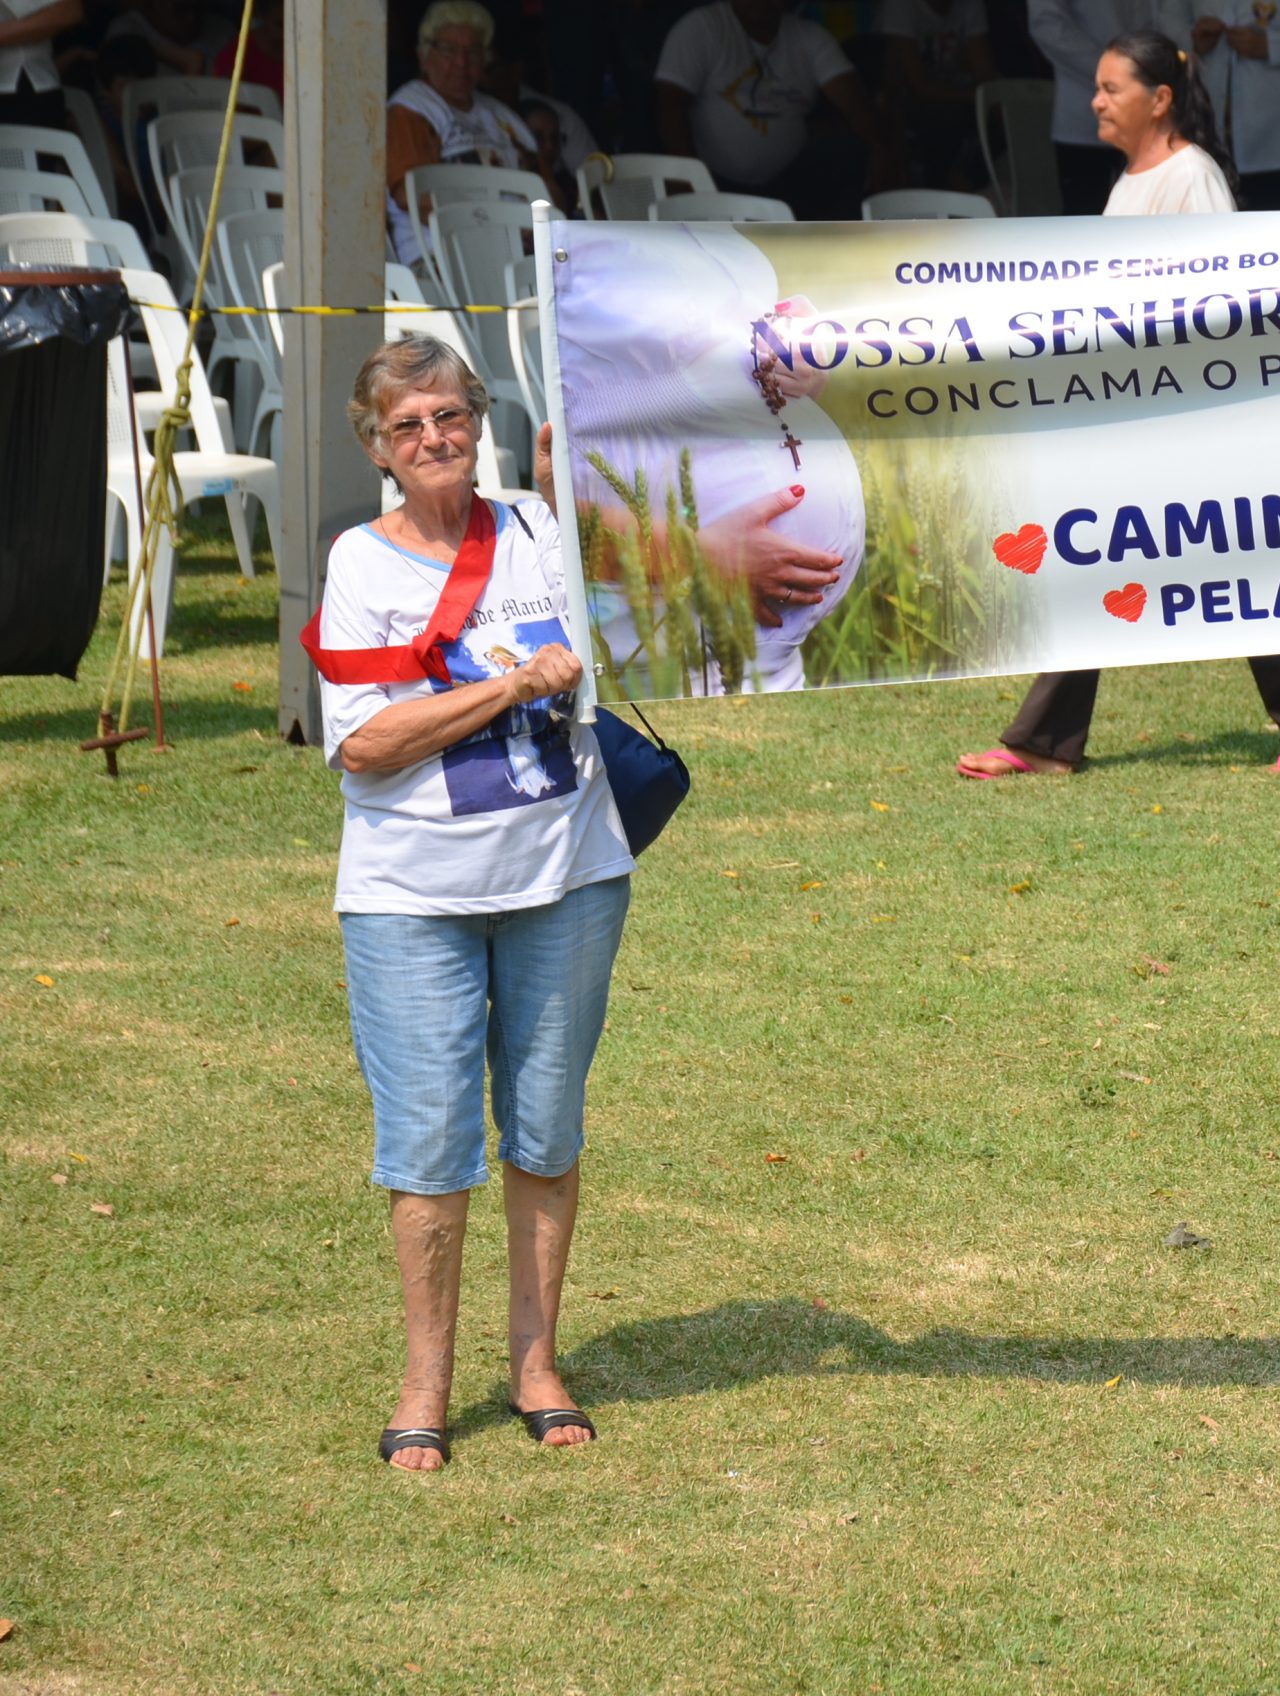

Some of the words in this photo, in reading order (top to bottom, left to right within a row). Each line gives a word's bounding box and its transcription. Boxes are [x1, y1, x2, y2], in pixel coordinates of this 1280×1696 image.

[895, 259, 1099, 285] COMUNIDADE
[1107, 254, 1230, 279] SENHOR
[750, 315, 986, 374] NOSSA
[866, 365, 1184, 419] CONCLAMA
[1202, 359, 1237, 391] O
[501, 596, 552, 621] Maria
